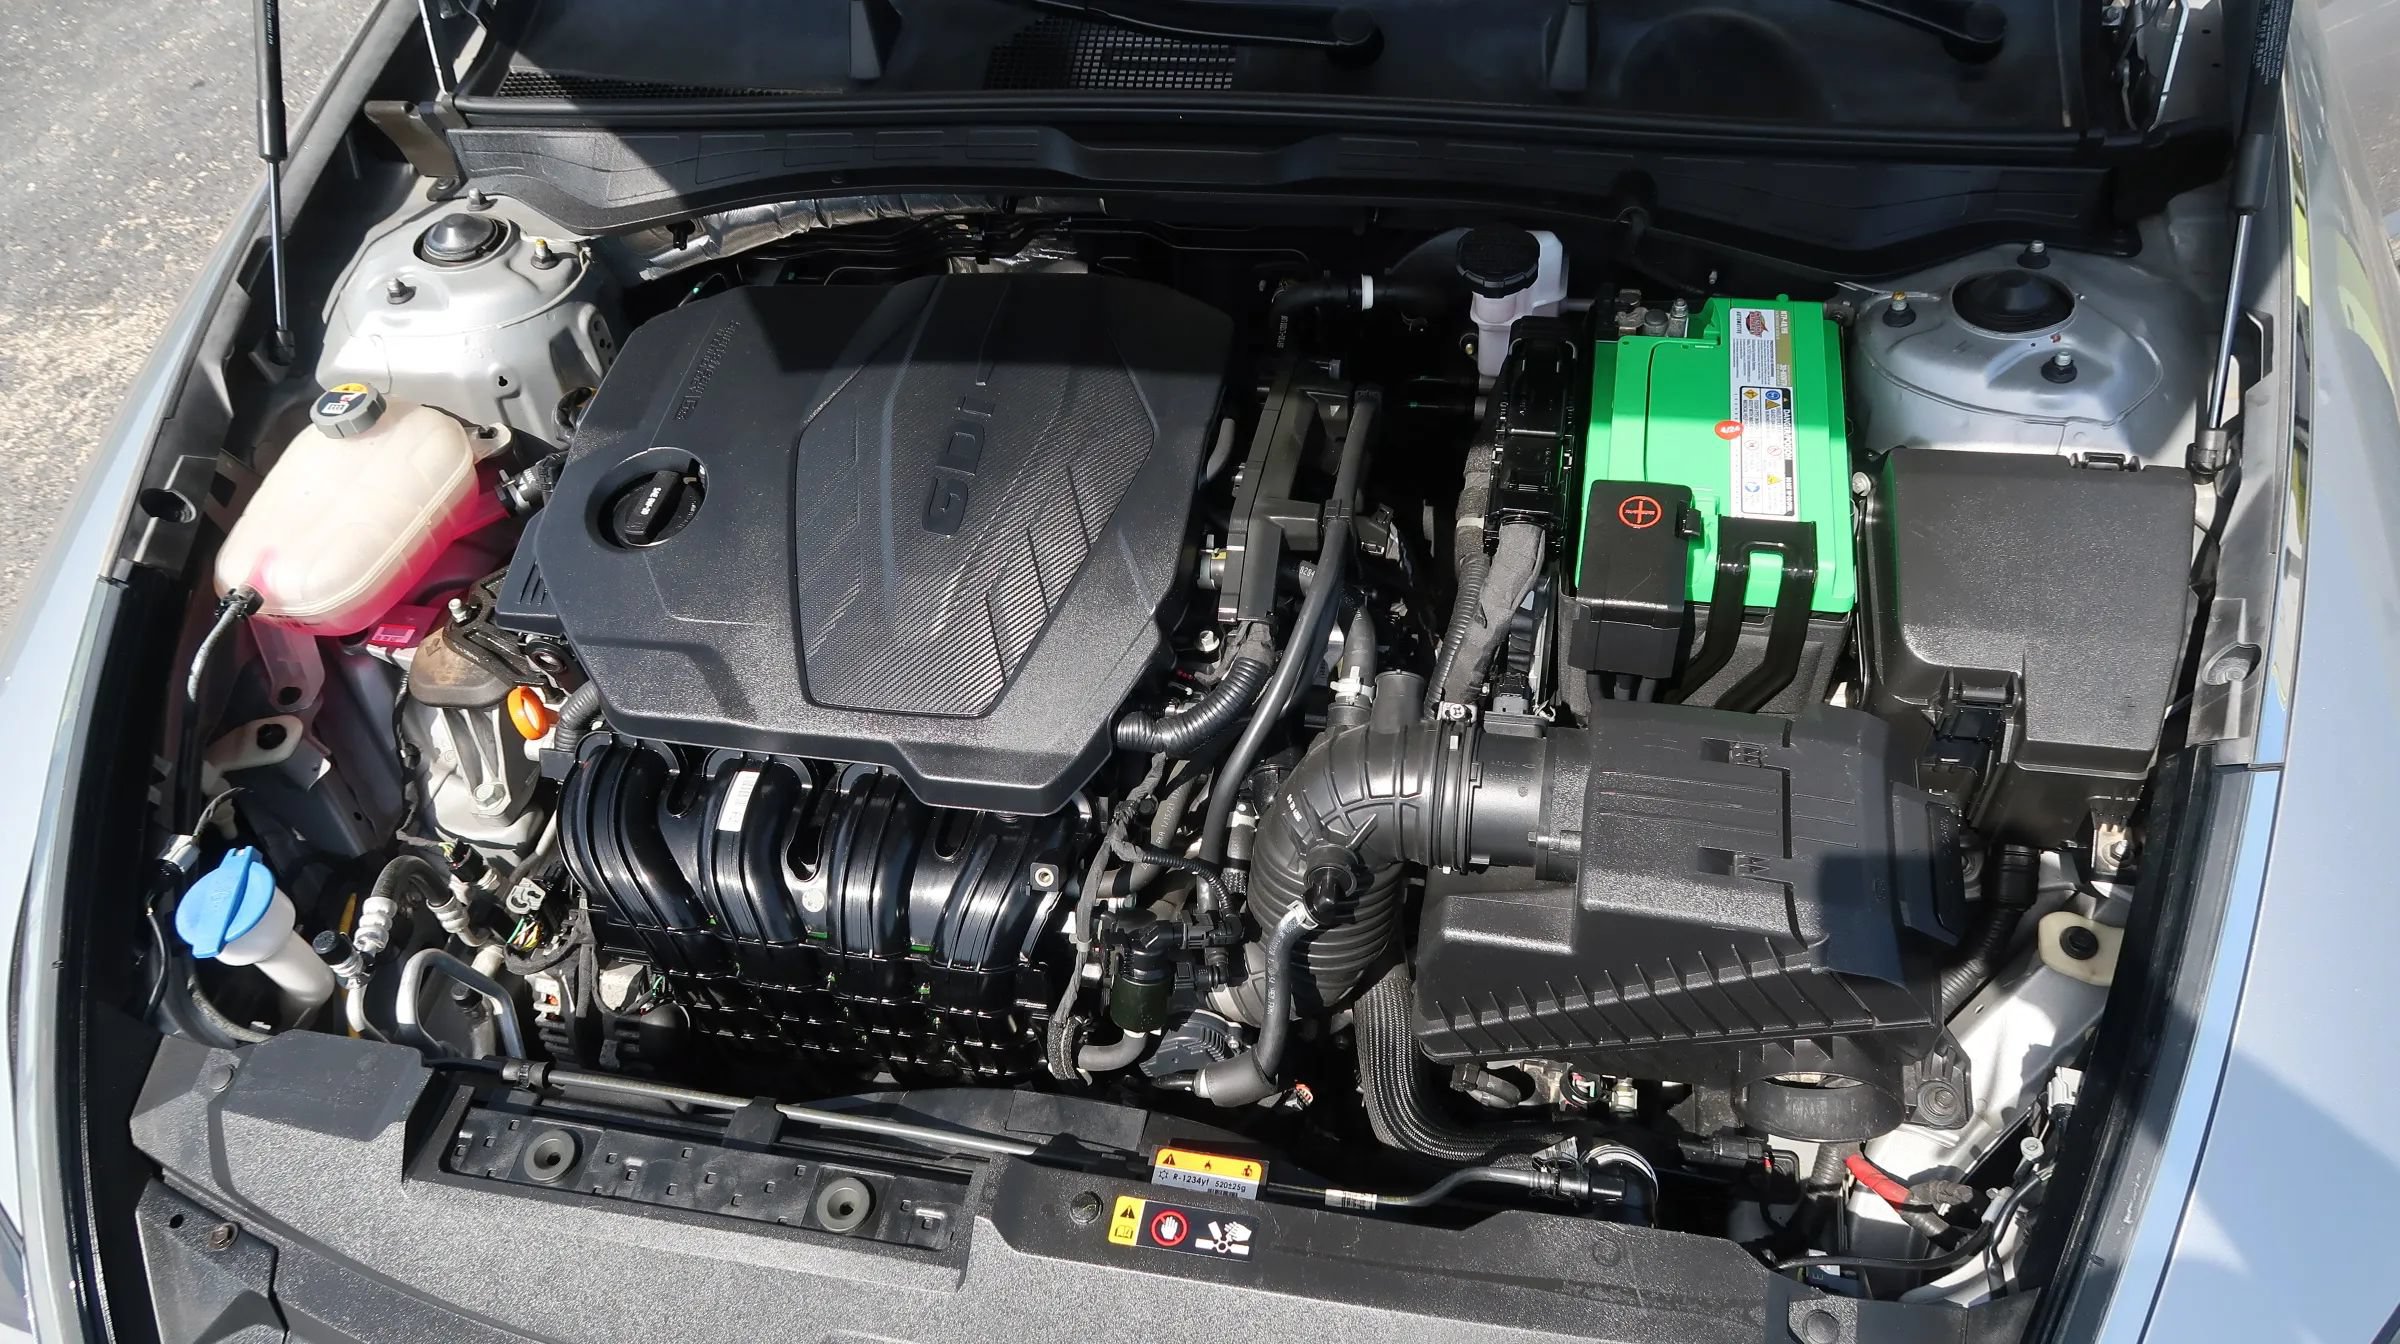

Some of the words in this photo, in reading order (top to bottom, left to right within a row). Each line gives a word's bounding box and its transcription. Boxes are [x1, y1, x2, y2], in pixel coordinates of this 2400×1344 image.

[650, 487, 662, 498] SAE
[1172, 1173, 1210, 1186] R-1234yf
[1214, 1180, 1247, 1193] 520±25g
